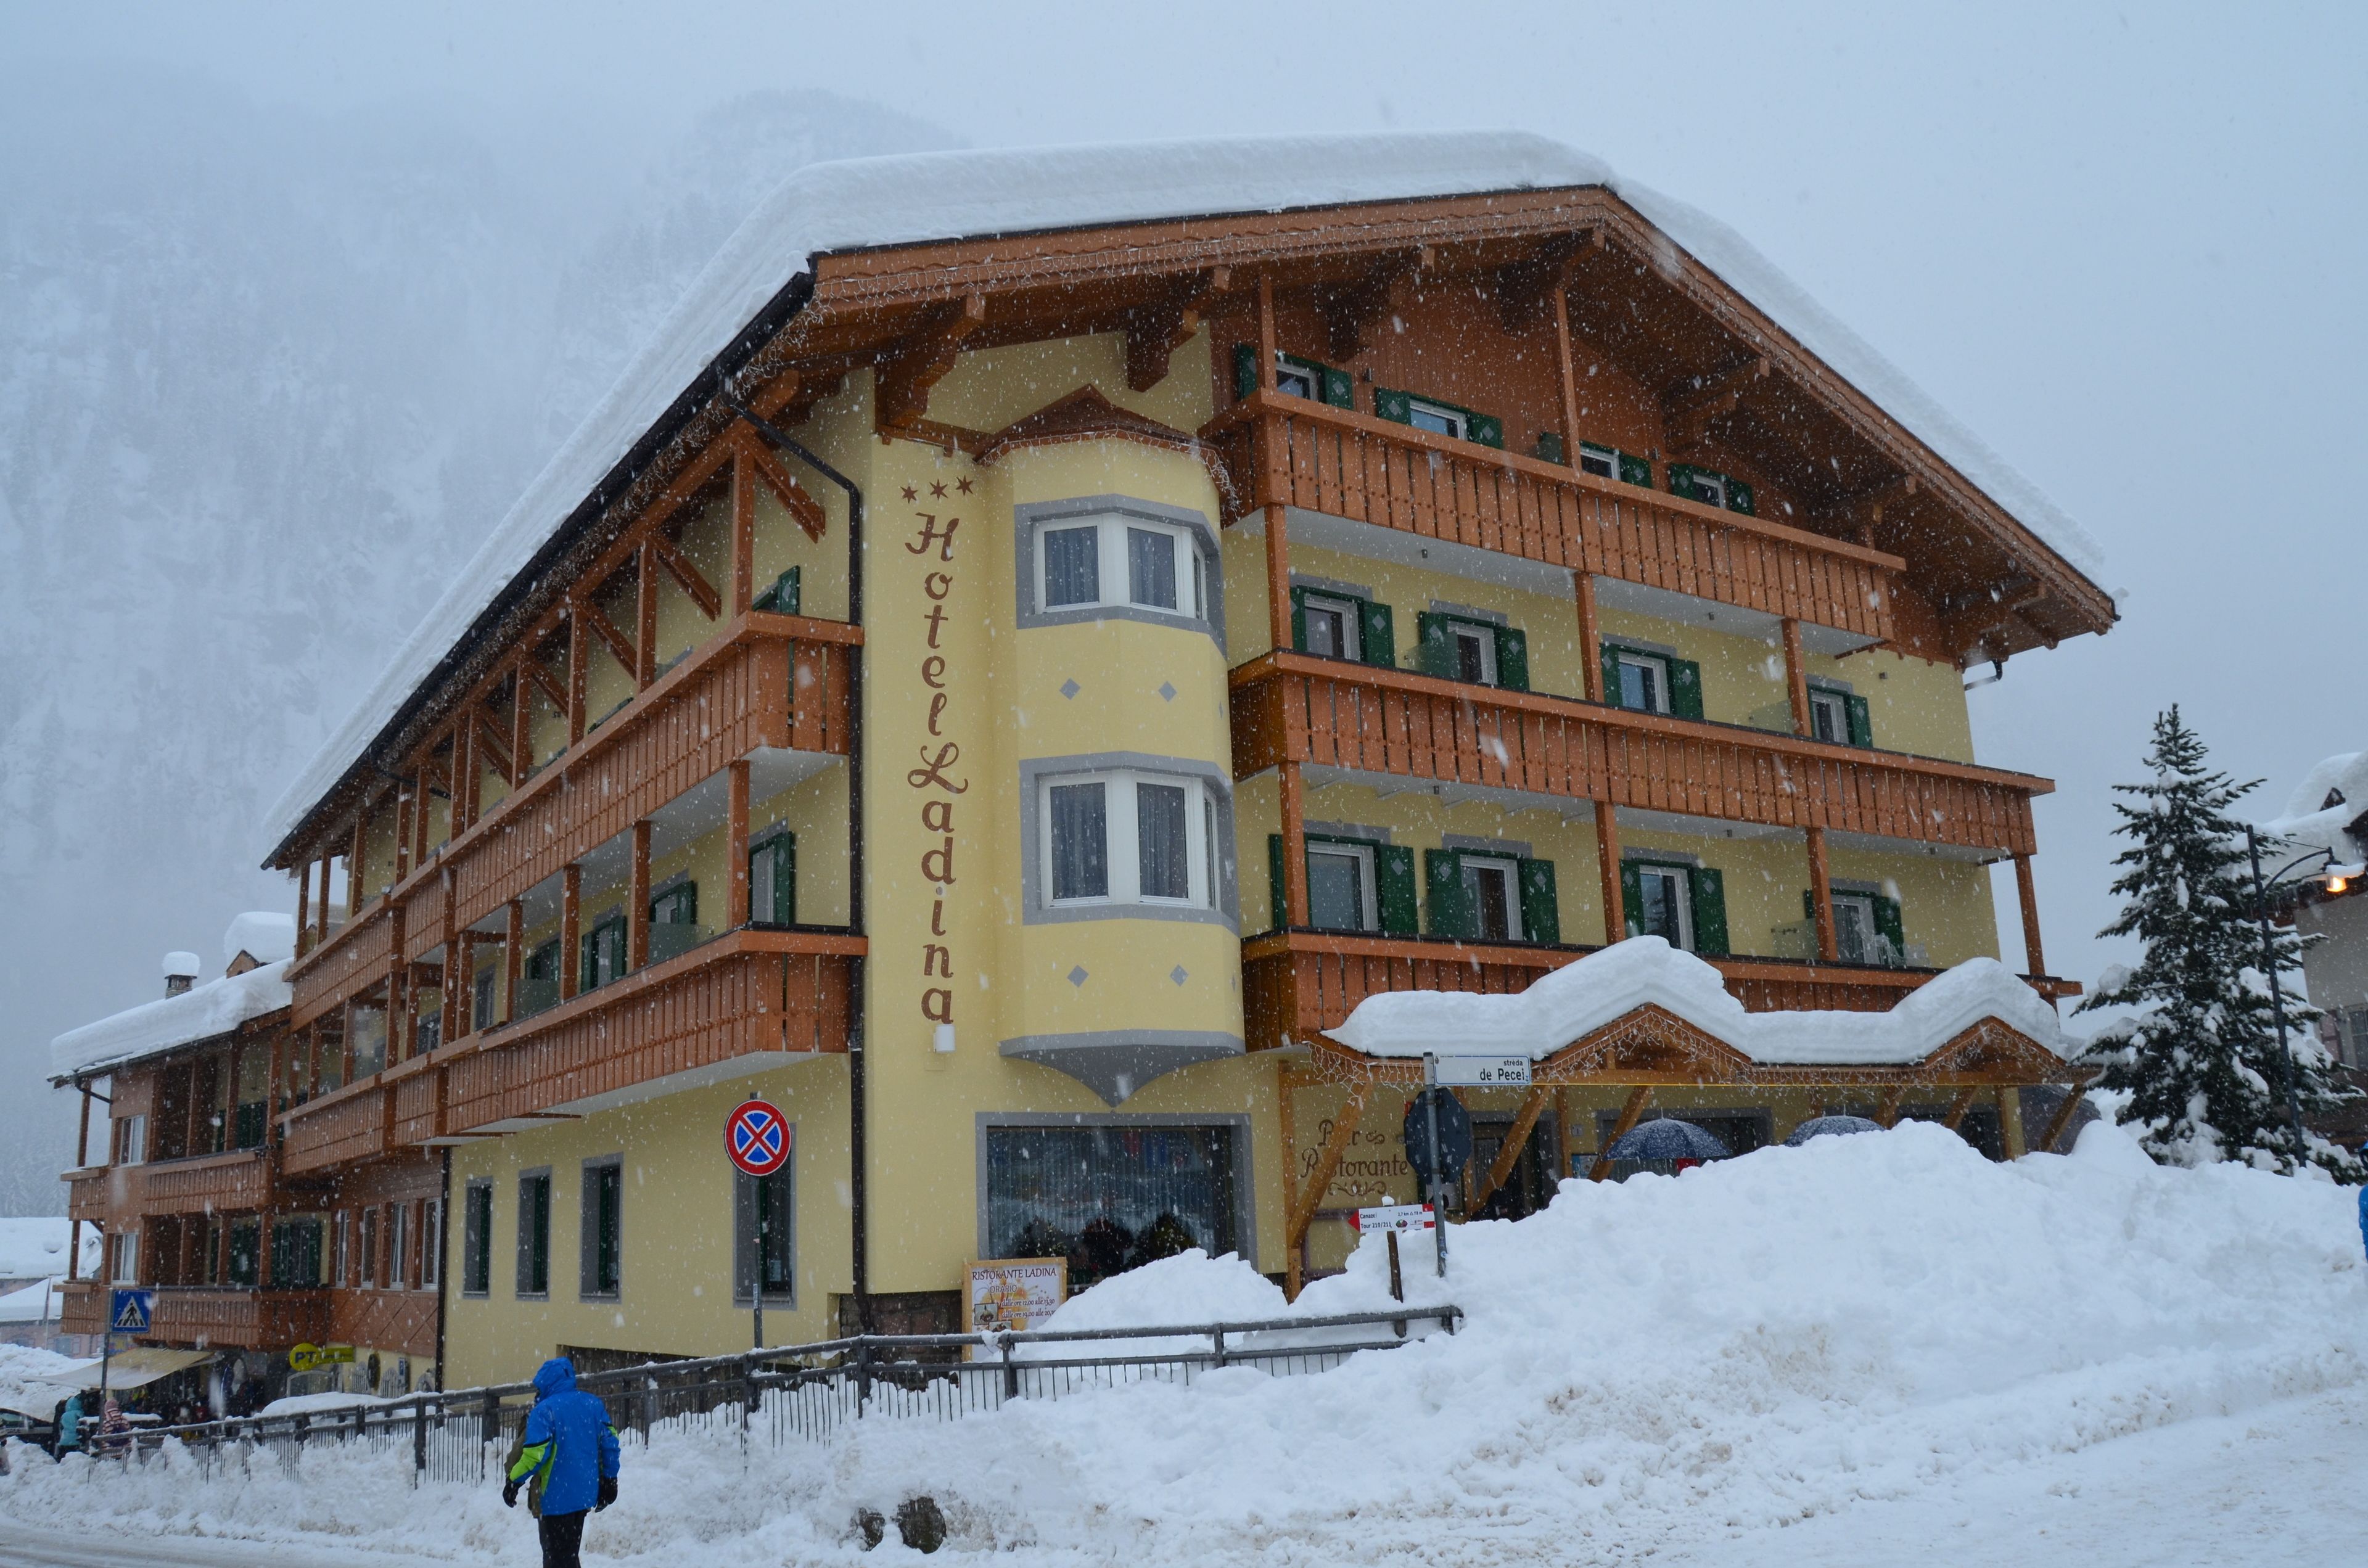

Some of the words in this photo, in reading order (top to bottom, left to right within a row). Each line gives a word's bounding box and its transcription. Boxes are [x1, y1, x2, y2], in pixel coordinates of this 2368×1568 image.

[905, 511, 960, 736] Hotel
[906, 742, 969, 1024] Ladina
[1480, 1068, 1492, 1081] de
[1498, 1068, 1525, 1081] Pecei
[1317, 1119, 1360, 1147] Br
[1301, 1147, 1408, 1178] Rtorante
[972, 1270, 1023, 1281] RISTORANTE
[1026, 1267, 1056, 1278] LADINA
[990, 1285, 1017, 1293] ORARIO
[1001, 1299, 1013, 1307] dalle
[1035, 1297, 1043, 1305] alle
[1001, 1310, 1013, 1318] dalle
[295, 1352, 315, 1363] PT
